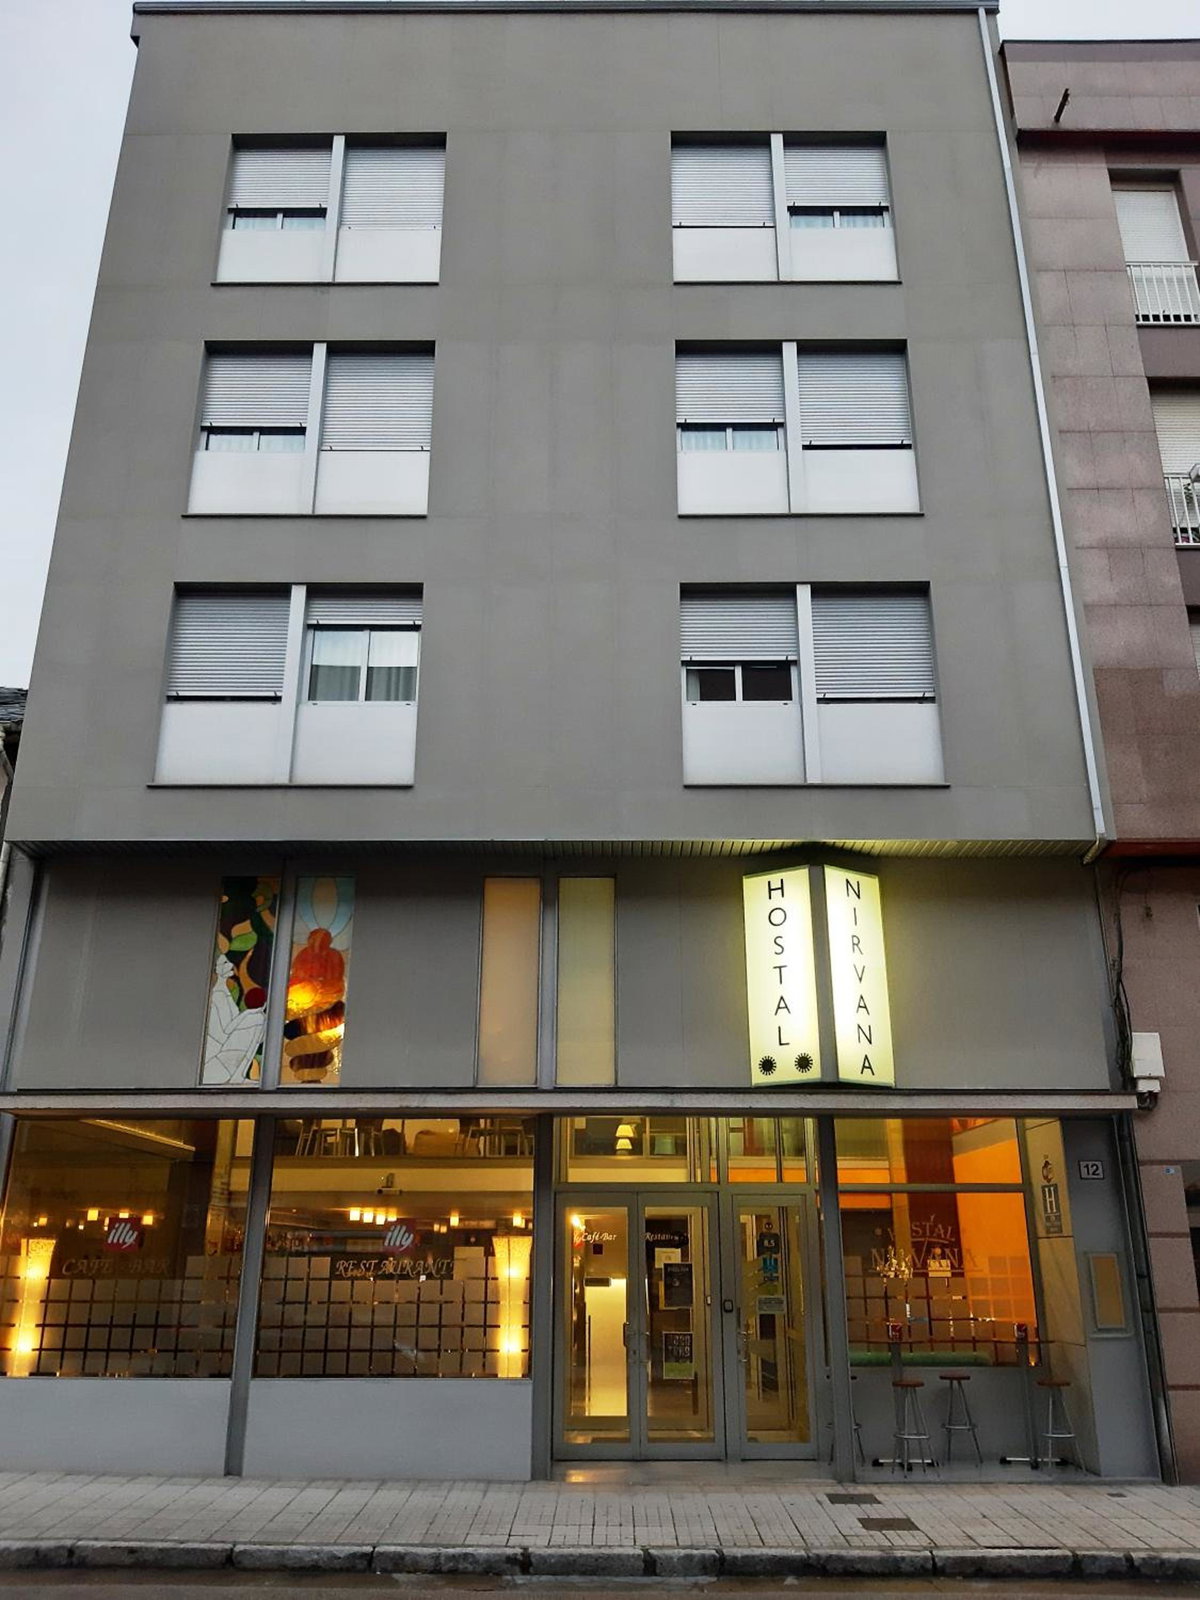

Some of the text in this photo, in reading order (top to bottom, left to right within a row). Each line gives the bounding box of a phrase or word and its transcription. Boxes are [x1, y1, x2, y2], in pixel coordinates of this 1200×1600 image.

[768, 878, 791, 1047] HOSTAL
[845, 878, 876, 1077] NIRVANA
[1084, 1163, 1100, 1176] 12
[1044, 1186, 1057, 1213] H
[107, 1222, 138, 1249] illy
[384, 1225, 414, 1252] illy
[334, 1259, 456, 1279] RESTAURANT
[870, 1247, 979, 1269] NVANA
